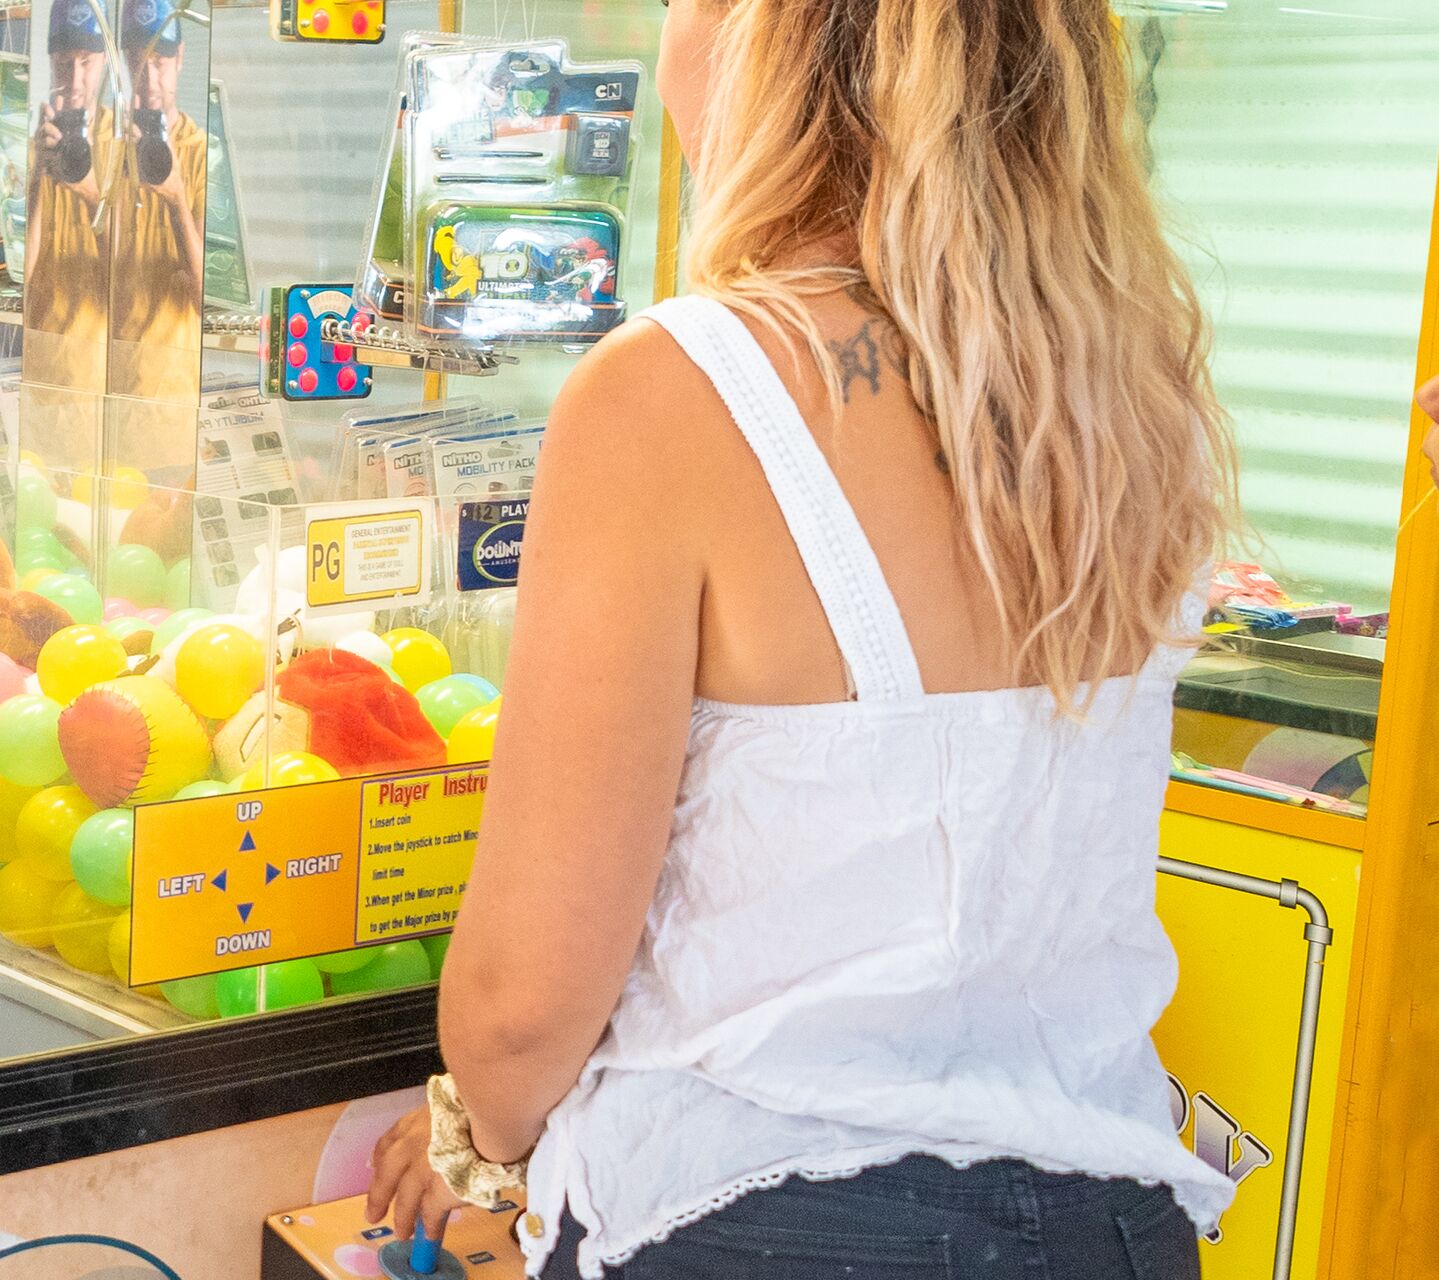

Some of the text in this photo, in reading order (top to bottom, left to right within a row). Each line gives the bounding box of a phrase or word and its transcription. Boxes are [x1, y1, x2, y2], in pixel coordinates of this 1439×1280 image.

[595, 81, 623, 100] CN
[457, 461, 505, 478] MOBILITY
[312, 541, 340, 582] PG
[379, 782, 430, 808] Player
[237, 801, 263, 822] UP
[394, 839, 404, 852] the
[405, 836, 433, 853] joystick
[435, 836, 442, 846] to
[443, 832, 462, 845] catch
[286, 853, 343, 879] RIGHT
[158, 873, 205, 899] LEFT
[404, 889, 416, 902] the
[392, 917, 403, 929] the
[215, 930, 271, 956] DOWN
